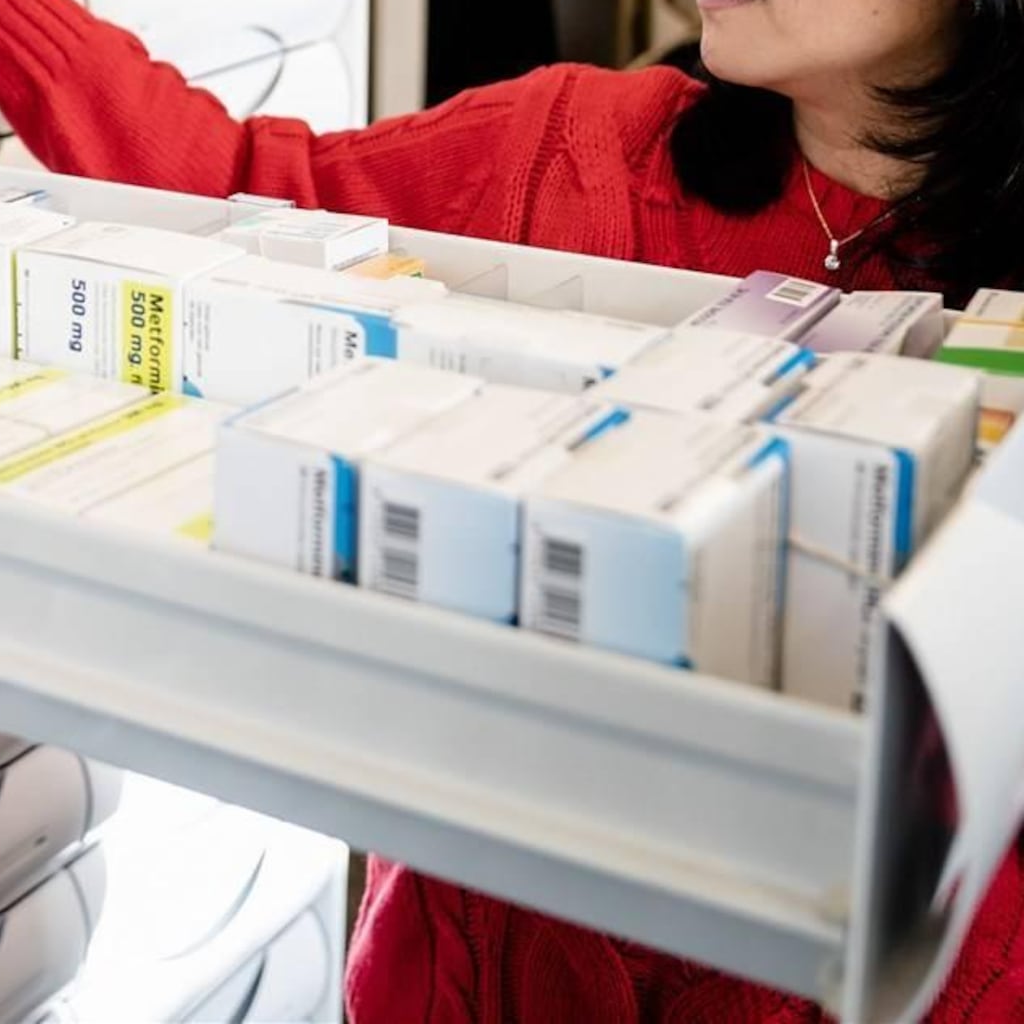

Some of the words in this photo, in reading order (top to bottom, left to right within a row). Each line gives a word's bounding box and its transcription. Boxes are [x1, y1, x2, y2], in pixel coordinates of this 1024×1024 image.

[72, 279, 87, 316] 500
[131, 290, 146, 328] 500
[69, 321, 83, 352] mg
